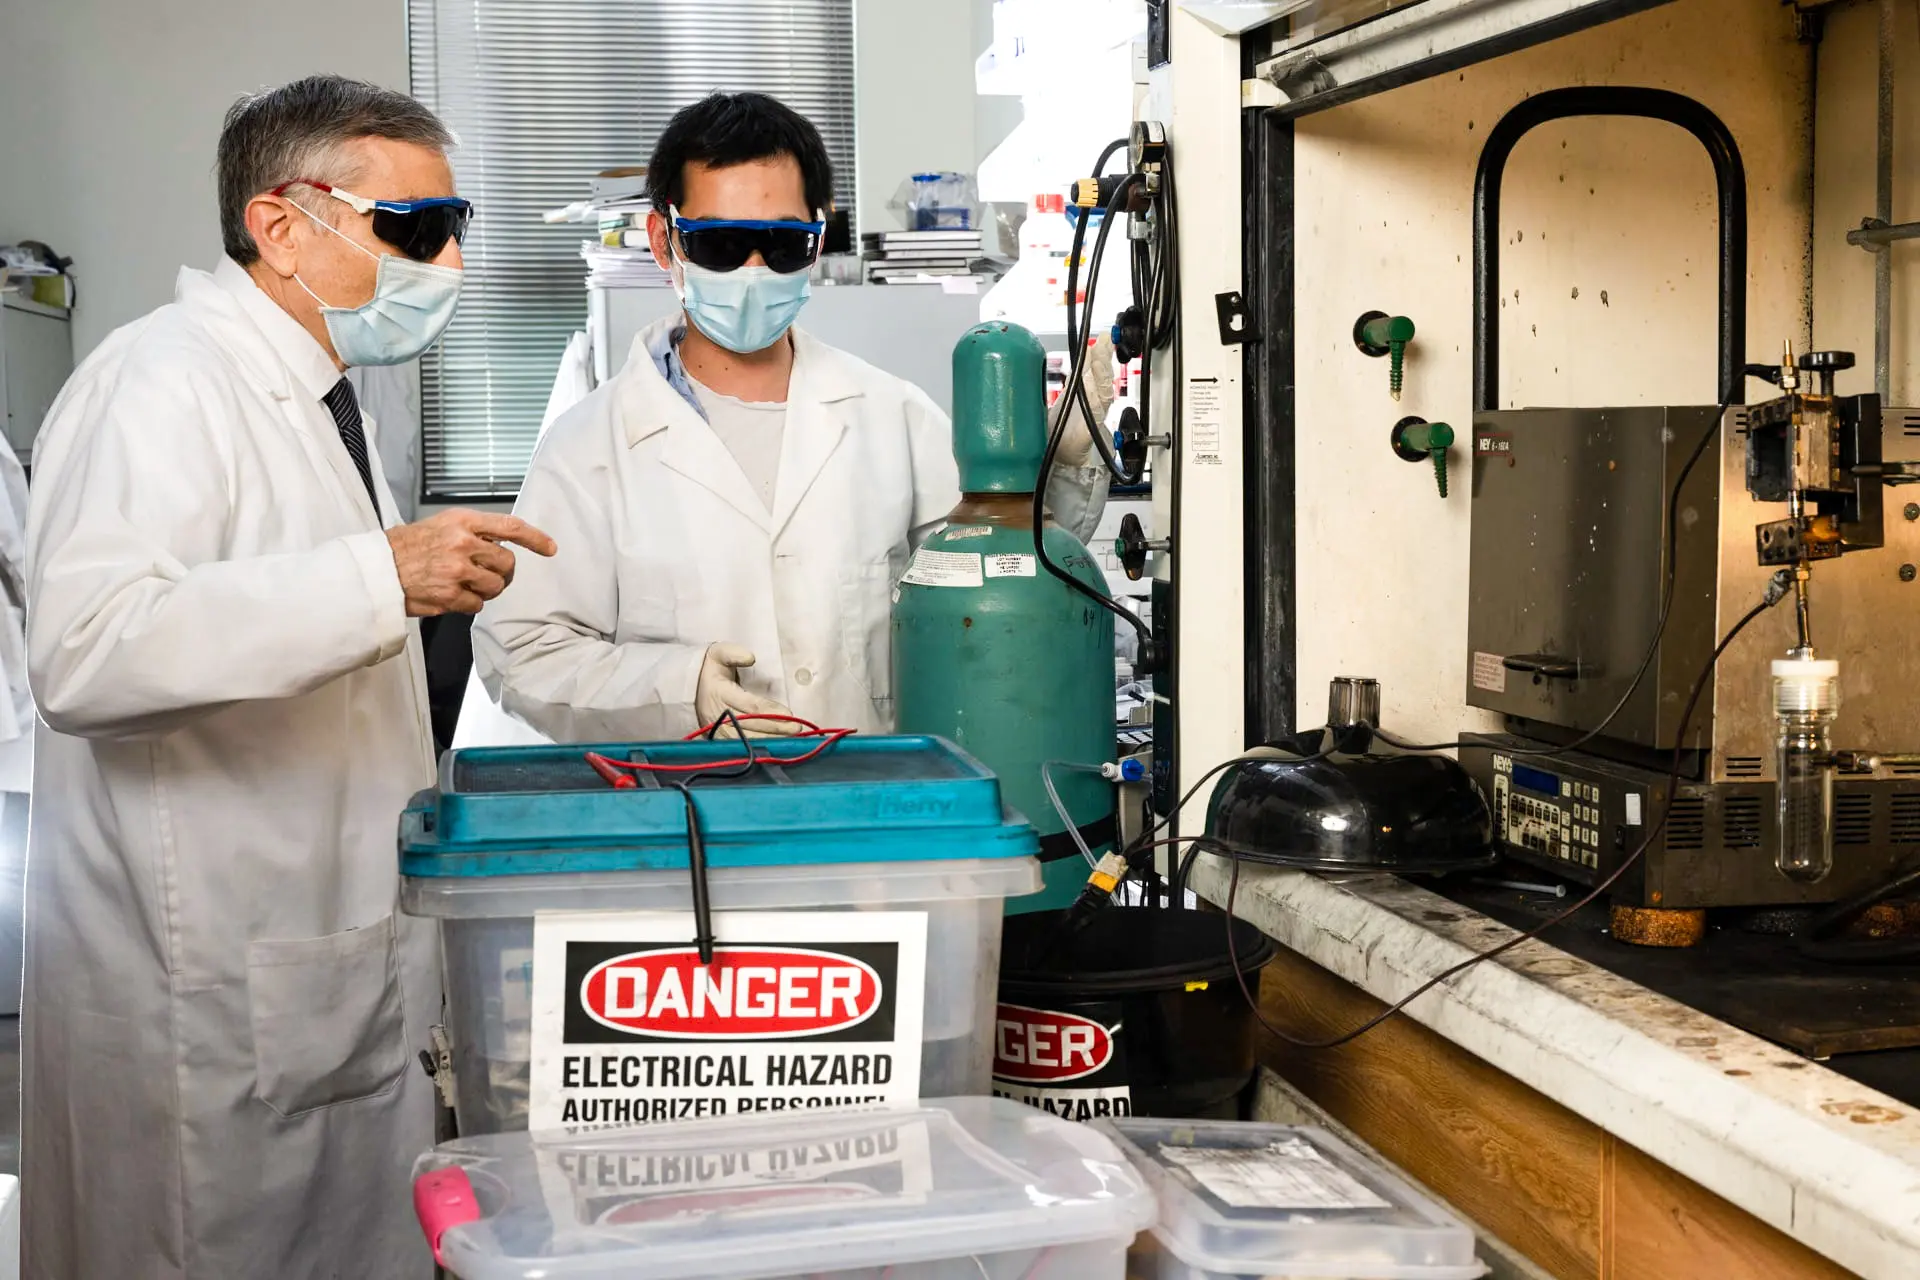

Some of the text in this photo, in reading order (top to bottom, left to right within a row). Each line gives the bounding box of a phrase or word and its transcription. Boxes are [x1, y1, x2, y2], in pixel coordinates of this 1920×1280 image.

[1480, 438, 1491, 450] NEY
[603, 966, 862, 1018] DANGER
[997, 1019, 1096, 1067] GER
[563, 1054, 892, 1087] ELECTRICAL HAZARD
[561, 1095, 886, 1122] AUTHORIZED PERSO
